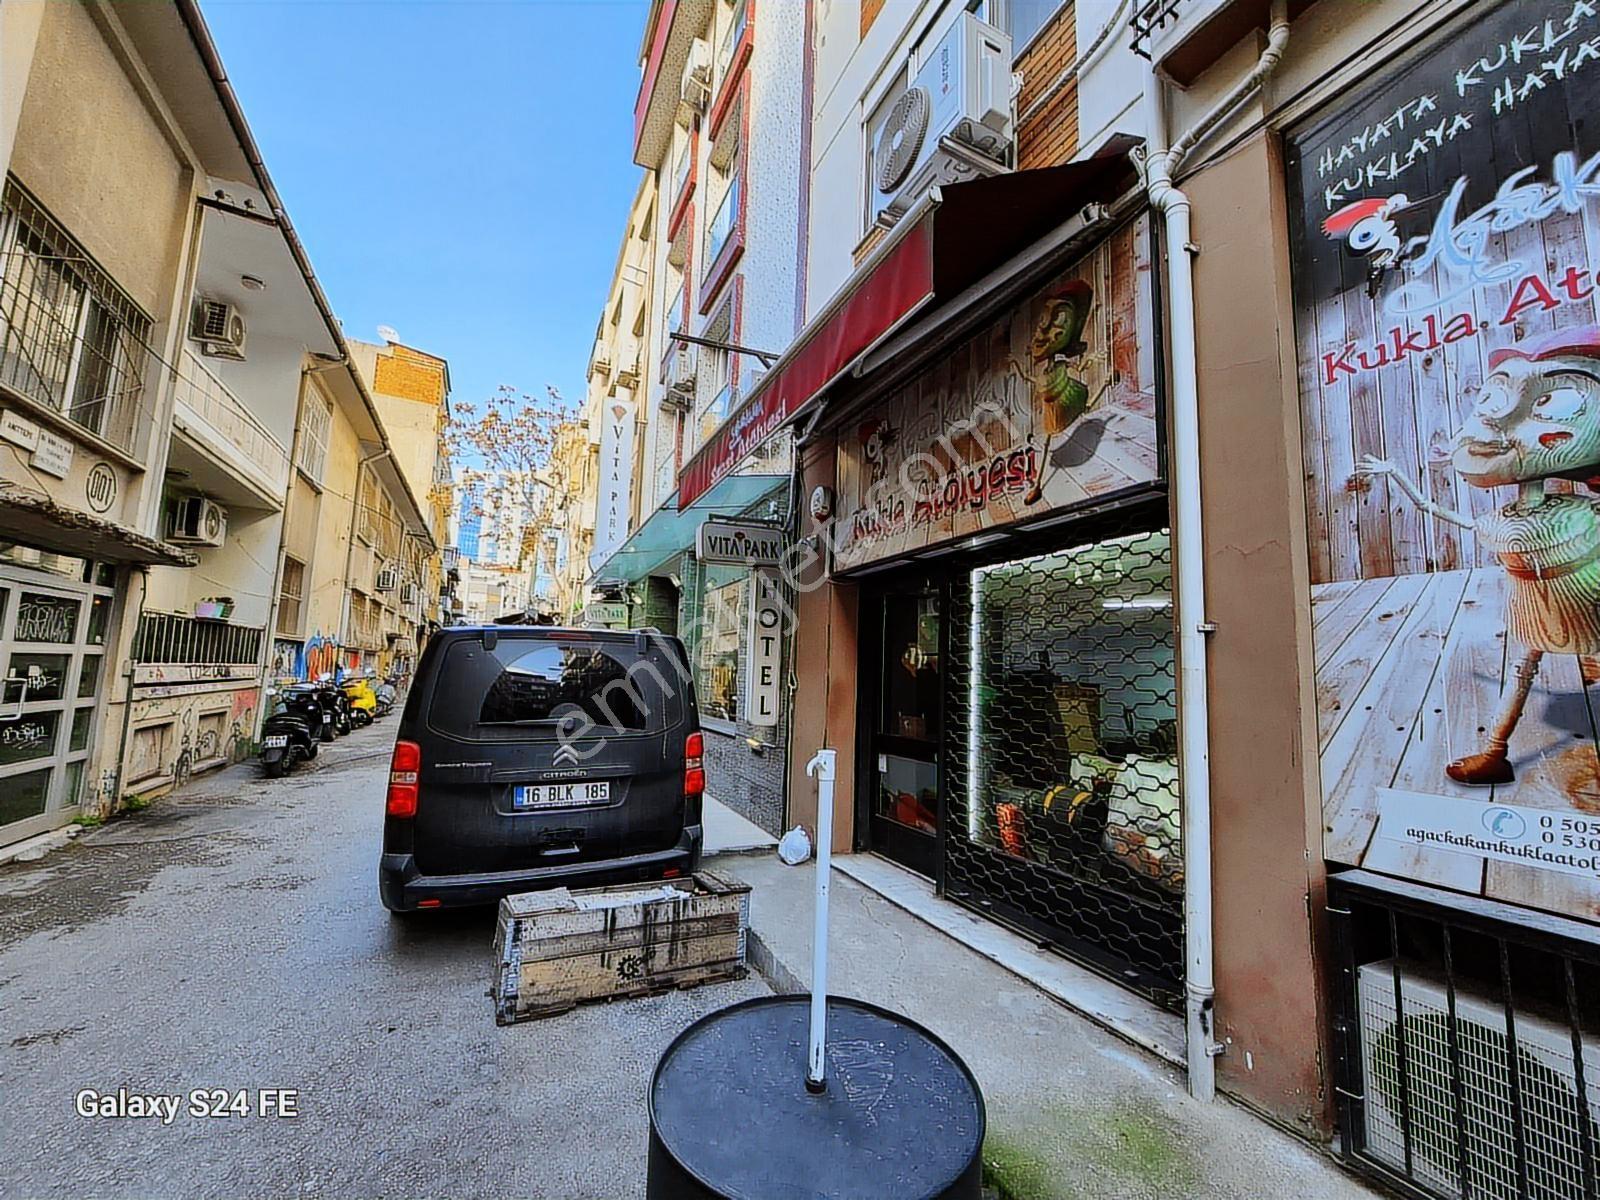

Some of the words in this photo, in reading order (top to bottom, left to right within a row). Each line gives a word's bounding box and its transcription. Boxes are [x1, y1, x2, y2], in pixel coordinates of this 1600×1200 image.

[1318, 94, 1438, 178] HAYATA
[1455, 0, 1597, 97] KUKLA
[1325, 113, 1475, 211] KUKLAYA
[1491, 36, 1600, 115] HAYA
[1321, 313, 1478, 386] Kukla
[1499, 266, 1600, 326] At
[607, 491, 618, 542] PARK
[708, 535, 740, 557] VITA
[744, 538, 779, 560] PARK
[758, 578, 779, 716] HOTEL
[525, 787, 541, 803] 16
[548, 785, 574, 802] BLK
[585, 783, 607, 800] 185
[1540, 815, 1553, 828] 0
[1560, 819, 1600, 836] 505
[1542, 831, 1554, 844] 0
[1406, 827, 1600, 877] agackakankuklaatol
